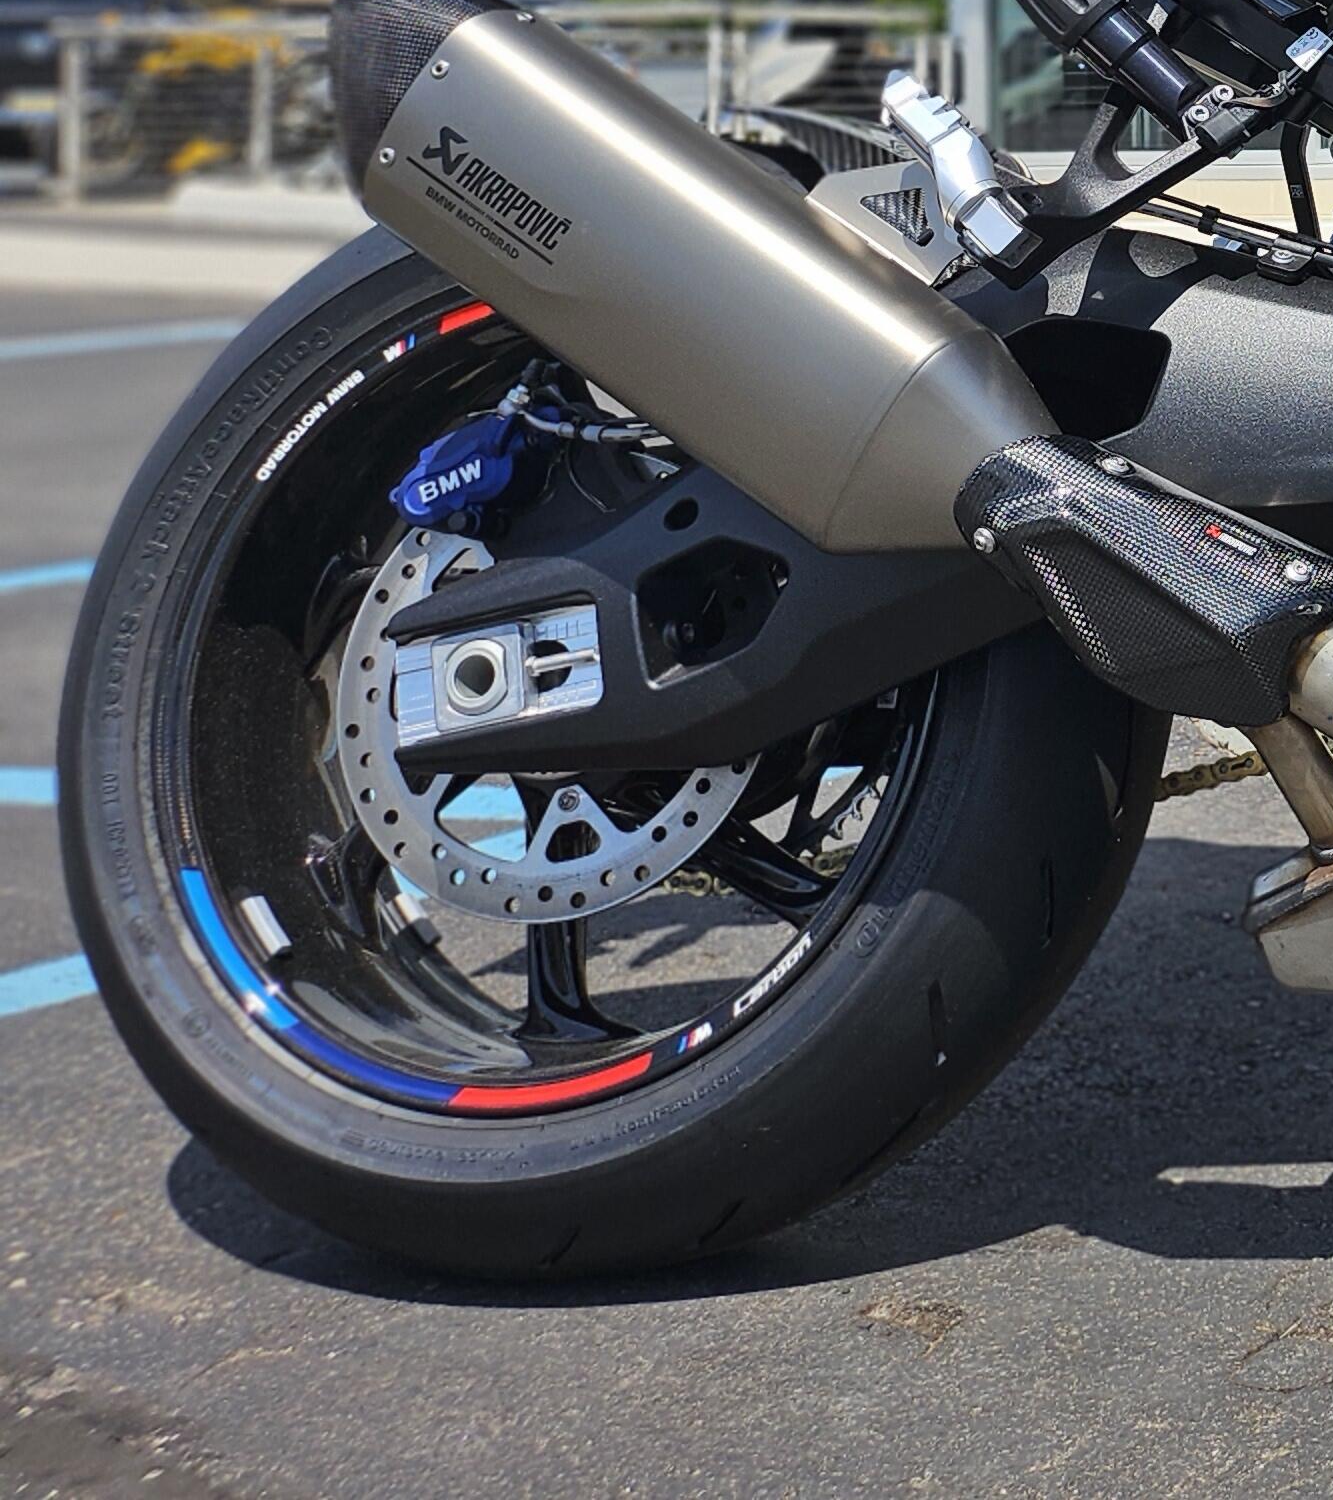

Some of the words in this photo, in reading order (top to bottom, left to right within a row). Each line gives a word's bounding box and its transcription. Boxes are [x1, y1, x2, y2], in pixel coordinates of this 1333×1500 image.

[425, 185, 457, 214] BMW
[455, 209, 520, 260] MOTORRAD
[255, 400, 329, 482] MOTORRAD
[418, 458, 481, 505] BMW
[732, 930, 813, 1018] Carbon
